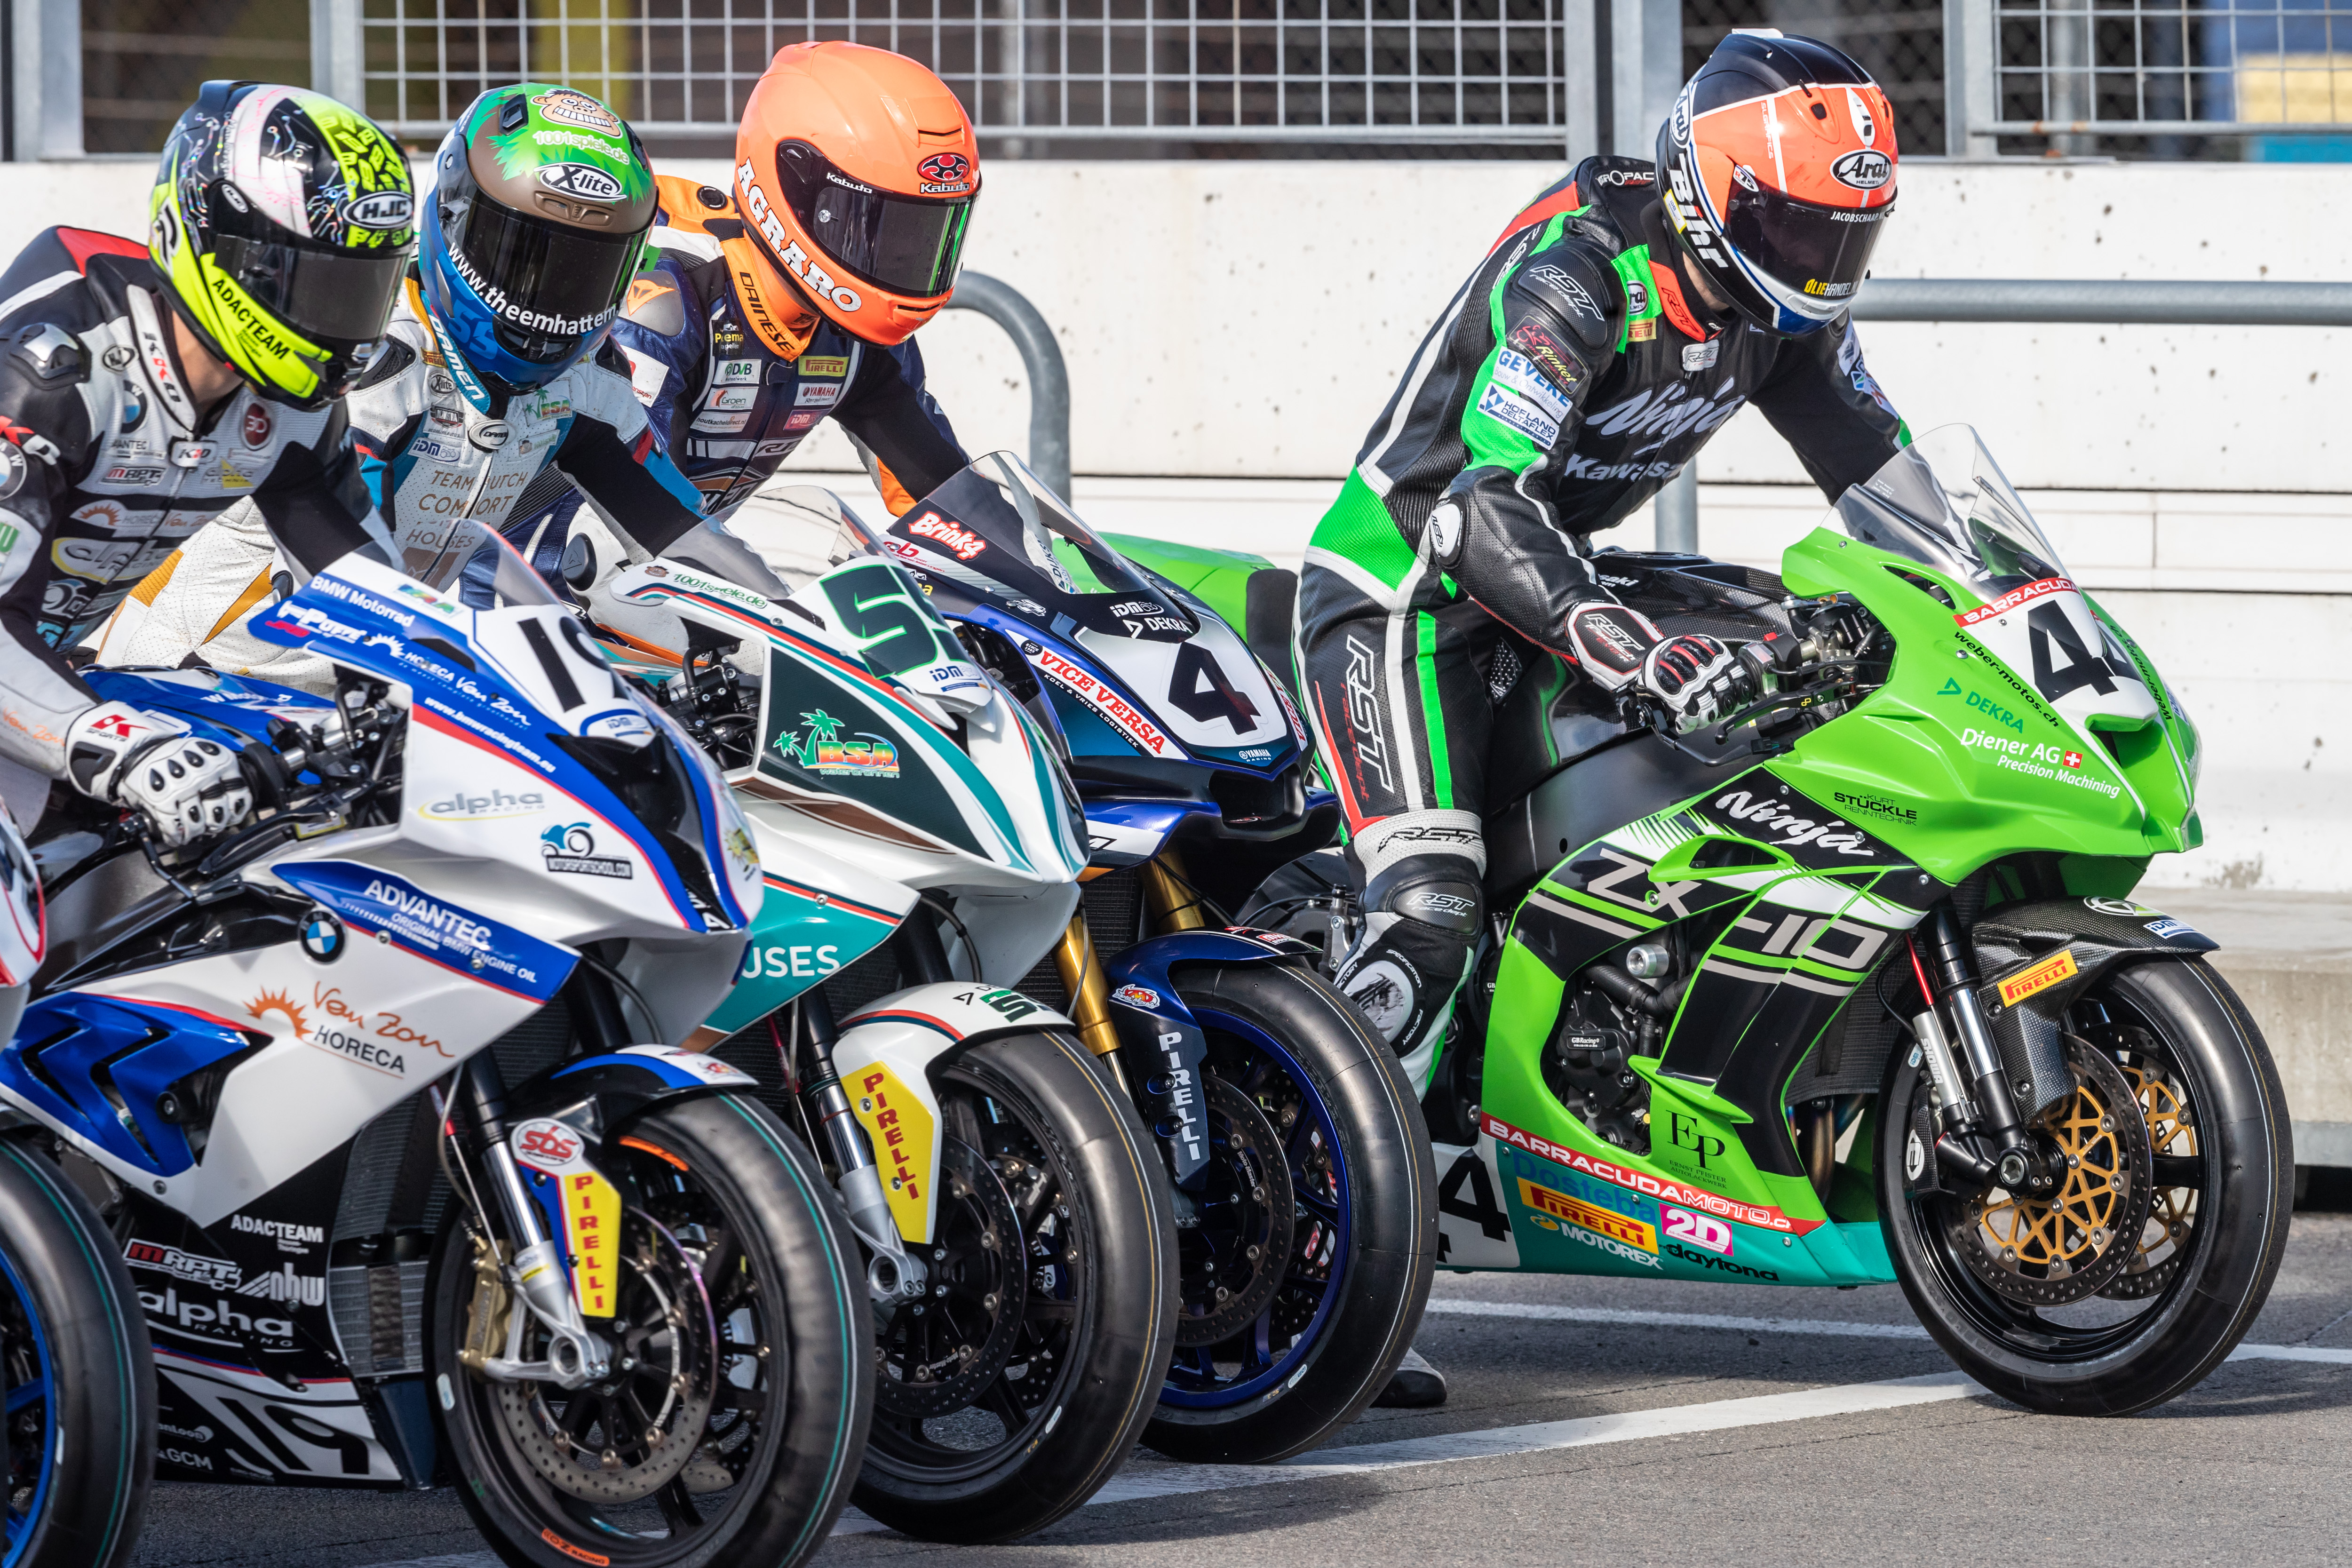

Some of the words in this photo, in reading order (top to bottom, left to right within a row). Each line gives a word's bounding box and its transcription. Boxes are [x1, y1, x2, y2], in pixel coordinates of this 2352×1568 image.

[533, 131, 630, 165] 1001spiele.de
[1836, 155, 1888, 179] Arai
[551, 164, 613, 195] X-lite
[826, 172, 873, 194] Kabuto
[920, 182, 970, 194] Kabuto
[361, 200, 408, 220] HJC
[737, 157, 863, 312] AGRARO
[739, 271, 795, 352] DAINESE
[1529, 264, 1605, 322] RST
[1629, 287, 1646, 304] rai
[1661, 287, 1700, 334] RST
[212, 278, 291, 360] ADACTEAM
[429, 314, 484, 400] DAMEN
[732, 363, 753, 375] DVB
[806, 359, 844, 373] PIRELLI
[1535, 346, 1577, 383] Rinket
[540, 399, 571, 418] BSA
[721, 397, 746, 405] Groen
[809, 387, 836, 397] YAMAHA
[1494, 366, 1511, 381] Bouw
[1510, 374, 1519, 385] &
[1518, 379, 1564, 420] Ontwikkeling
[1501, 407, 1555, 441] DELTAFLEX
[1503, 401, 1556, 435] HOFLAND
[429, 470, 476, 491] TEAM
[486, 471, 529, 490] UTCH
[418, 493, 514, 518] COMORT
[1598, 573, 1640, 587] saki
[310, 575, 352, 600] BMW
[348, 590, 416, 628] Motorrad
[1109, 602, 1142, 617] iDM
[1963, 580, 2079, 624] BARRACUDA
[1144, 617, 1194, 634] DEKRA
[1584, 613, 1646, 651] RST
[1025, 642, 1040, 652] SINCE
[2027, 599, 2120, 704] 4
[404, 652, 455, 682] HOECA
[455, 676, 488, 702] Van
[490, 697, 532, 726] Zon
[929, 665, 963, 683] iDM
[1167, 641, 1262, 736] 4
[1954, 631, 2060, 728] weber-motos.ch
[1040, 650, 1097, 693] VICE
[1095, 685, 1166, 755] VERSA
[1044, 673, 1065, 690] KOEL
[1074, 692, 1098, 713] VRIES
[1099, 712, 1139, 748] LOGISTIEK
[1345, 634, 1395, 794] RST
[1966, 691, 2024, 734] DEKRA
[424, 696, 556, 773] www.bmwracingteam.eu
[1246, 748, 1272, 758] YAMAHA
[1959, 728, 2029, 757] Diener
[2034, 742, 2062, 765] AG
[818, 740, 899, 768] BSA
[819, 768, 900, 779] waterbronnen
[1997, 755, 2055, 780] Precision
[2055, 769, 2121, 799] Machining
[430, 789, 544, 814] alpha
[1833, 791, 1917, 820] STÜCKLE
[1844, 804, 1917, 827] RENNTECHNIK
[1866, 793, 1896, 805] KURT
[1715, 789, 1874, 856] Ninja
[364, 879, 492, 948] ADVANTEC
[1406, 892, 1476, 910] RST
[391, 912, 442, 942] ORIGINAL
[441, 937, 472, 956] BMW
[471, 948, 517, 975] ENGINE
[516, 967, 538, 984] OIL
[2005, 957, 2068, 1001] PIRELLI
[314, 979, 365, 1030] Van
[374, 1011, 456, 1059] Zon
[314, 1025, 405, 1075] HORECA
[1920, 1038, 1944, 1084] SHOWA
[1158, 1031, 1201, 1161] PIRELLI
[863, 1072, 918, 1200] PIRELLI
[1513, 1151, 1656, 1224] Dosteba
[1669, 1160, 1694, 1172] ERNST
[1695, 1169, 1727, 1183] PFISTER
[1671, 1166, 1727, 1190] AUTOLACKWERK
[1438, 1146, 1512, 1244] 4
[230, 1214, 325, 1243] ADACTEAM
[1529, 1185, 1645, 1246] PIRELLI
[1665, 1208, 1731, 1247] 2D
[574, 1175, 604, 1310] PIRELLI
[1561, 1222, 1661, 1271] MOTOREX
[1668, 1229, 1724, 1251] 2d-datarecording.com
[1667, 1243, 1780, 1282] daytona
[137, 1286, 294, 1338] alpha
